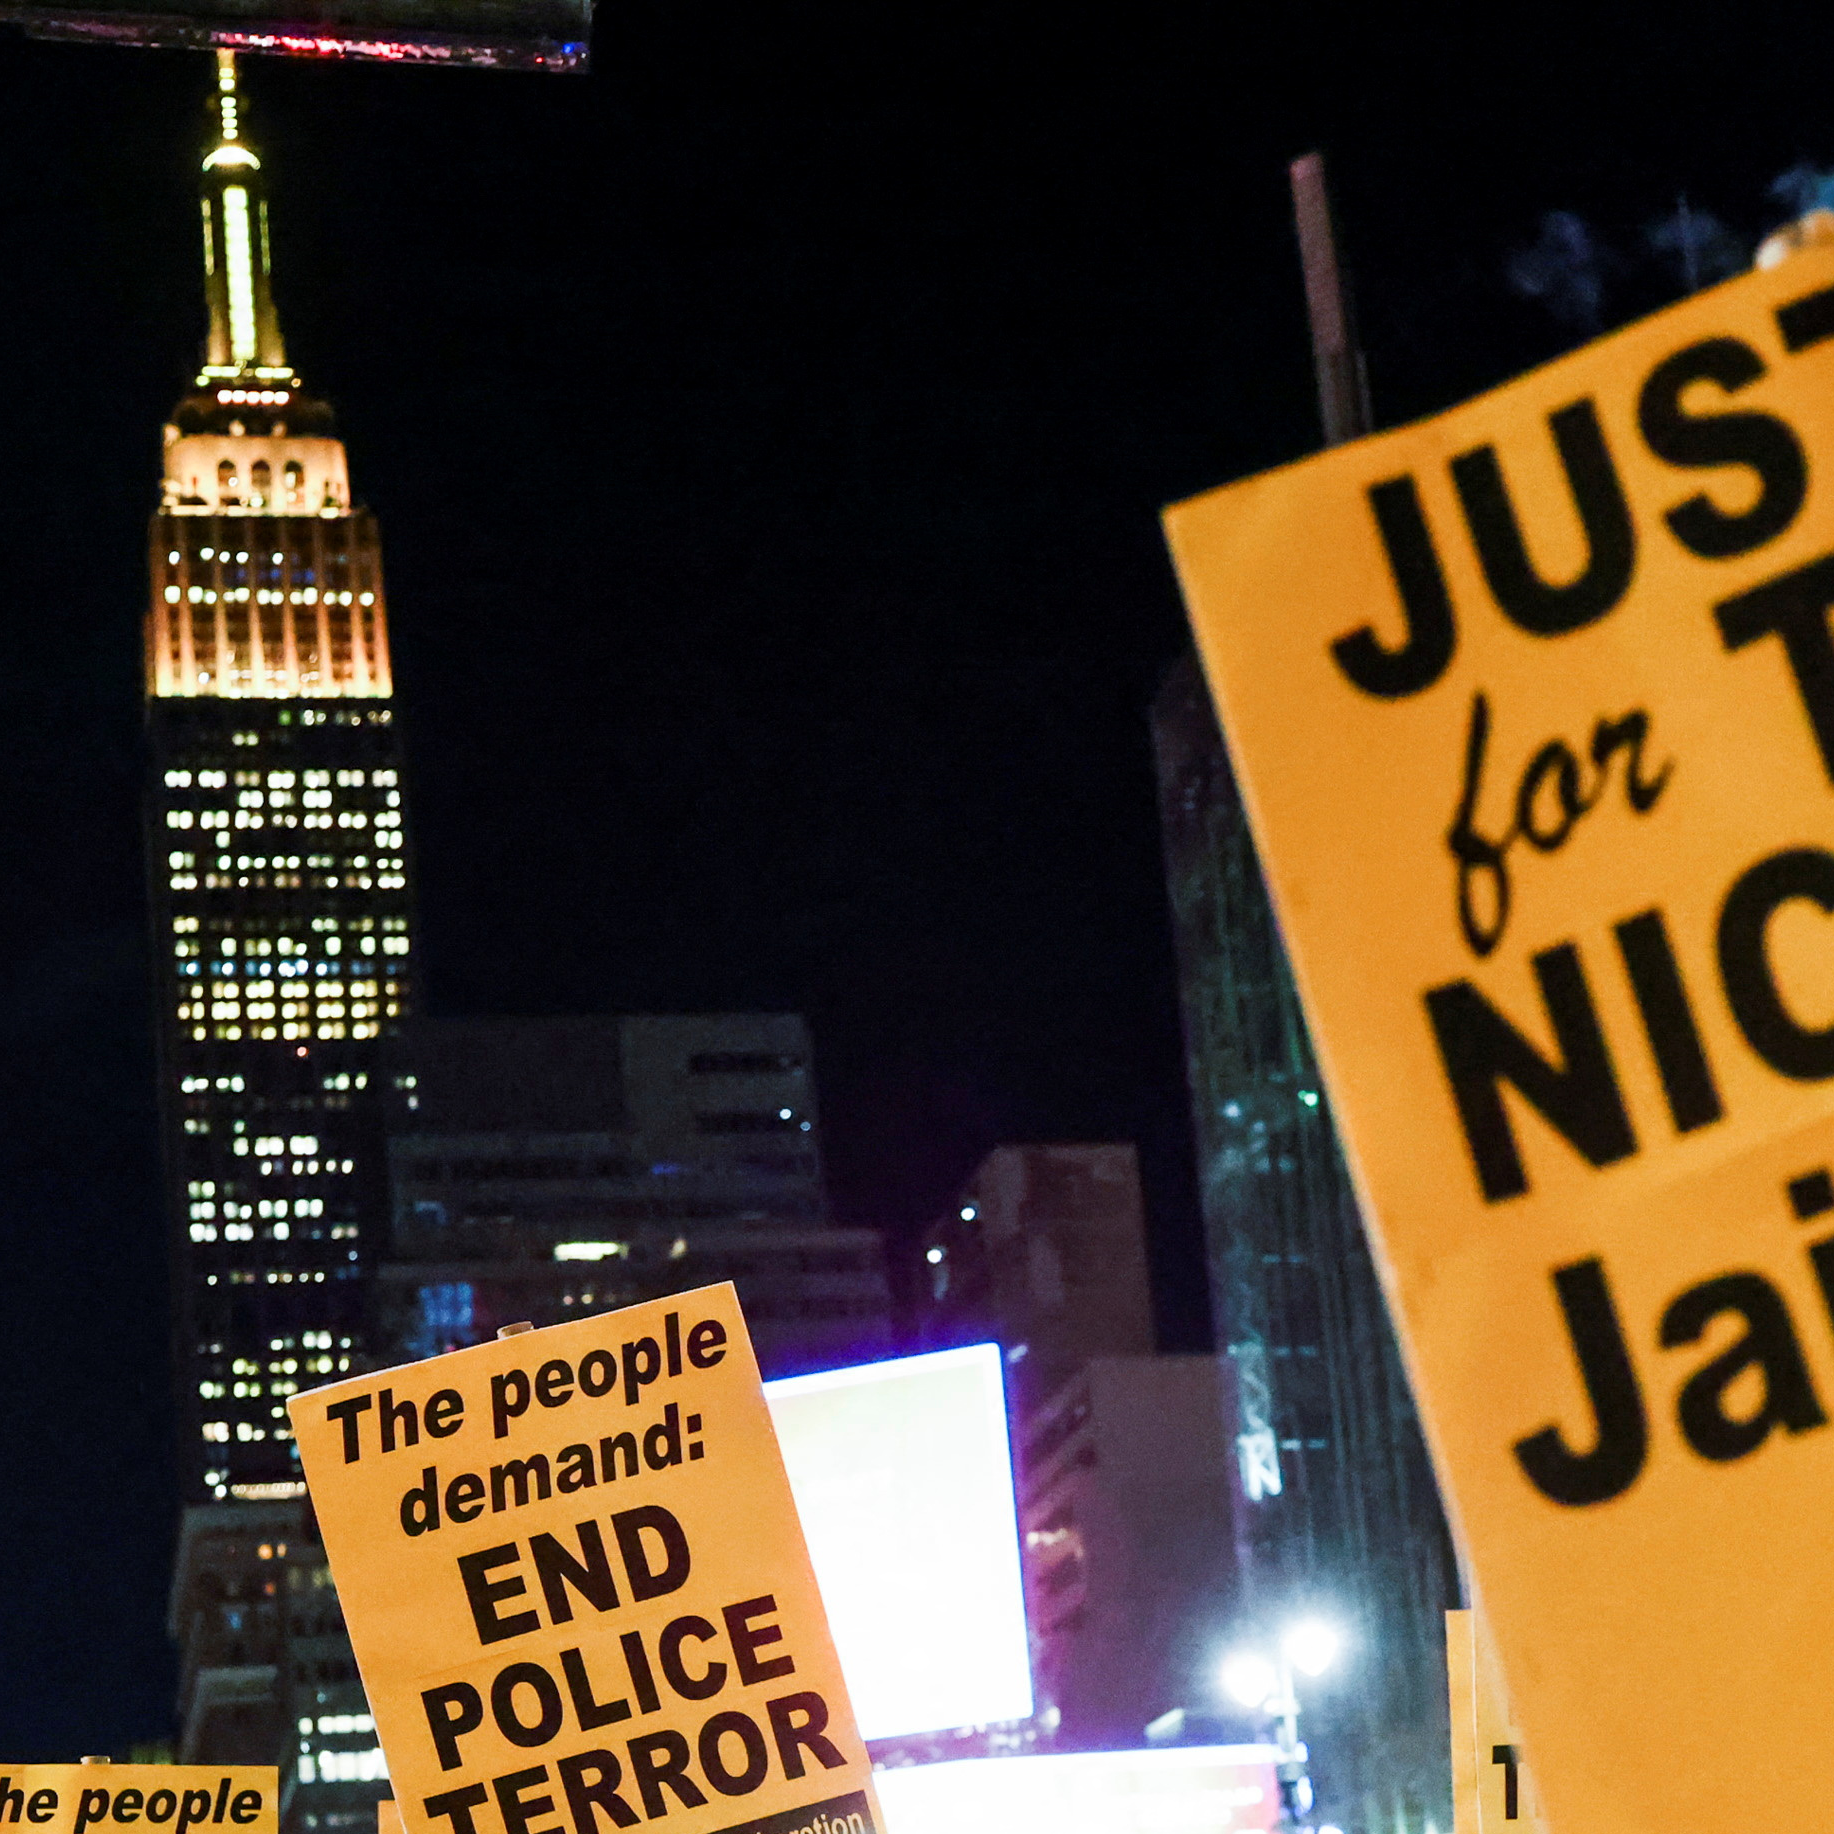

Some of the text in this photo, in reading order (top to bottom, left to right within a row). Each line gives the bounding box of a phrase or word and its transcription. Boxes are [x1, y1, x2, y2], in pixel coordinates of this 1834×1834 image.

[1444, 688, 1668, 958] for
[327, 1313, 728, 1465] The people
[400, 1404, 705, 1537] demand:
[457, 1504, 692, 1646] END
[420, 1594, 795, 1772] POLICE
[74, 1778, 262, 1834] people
